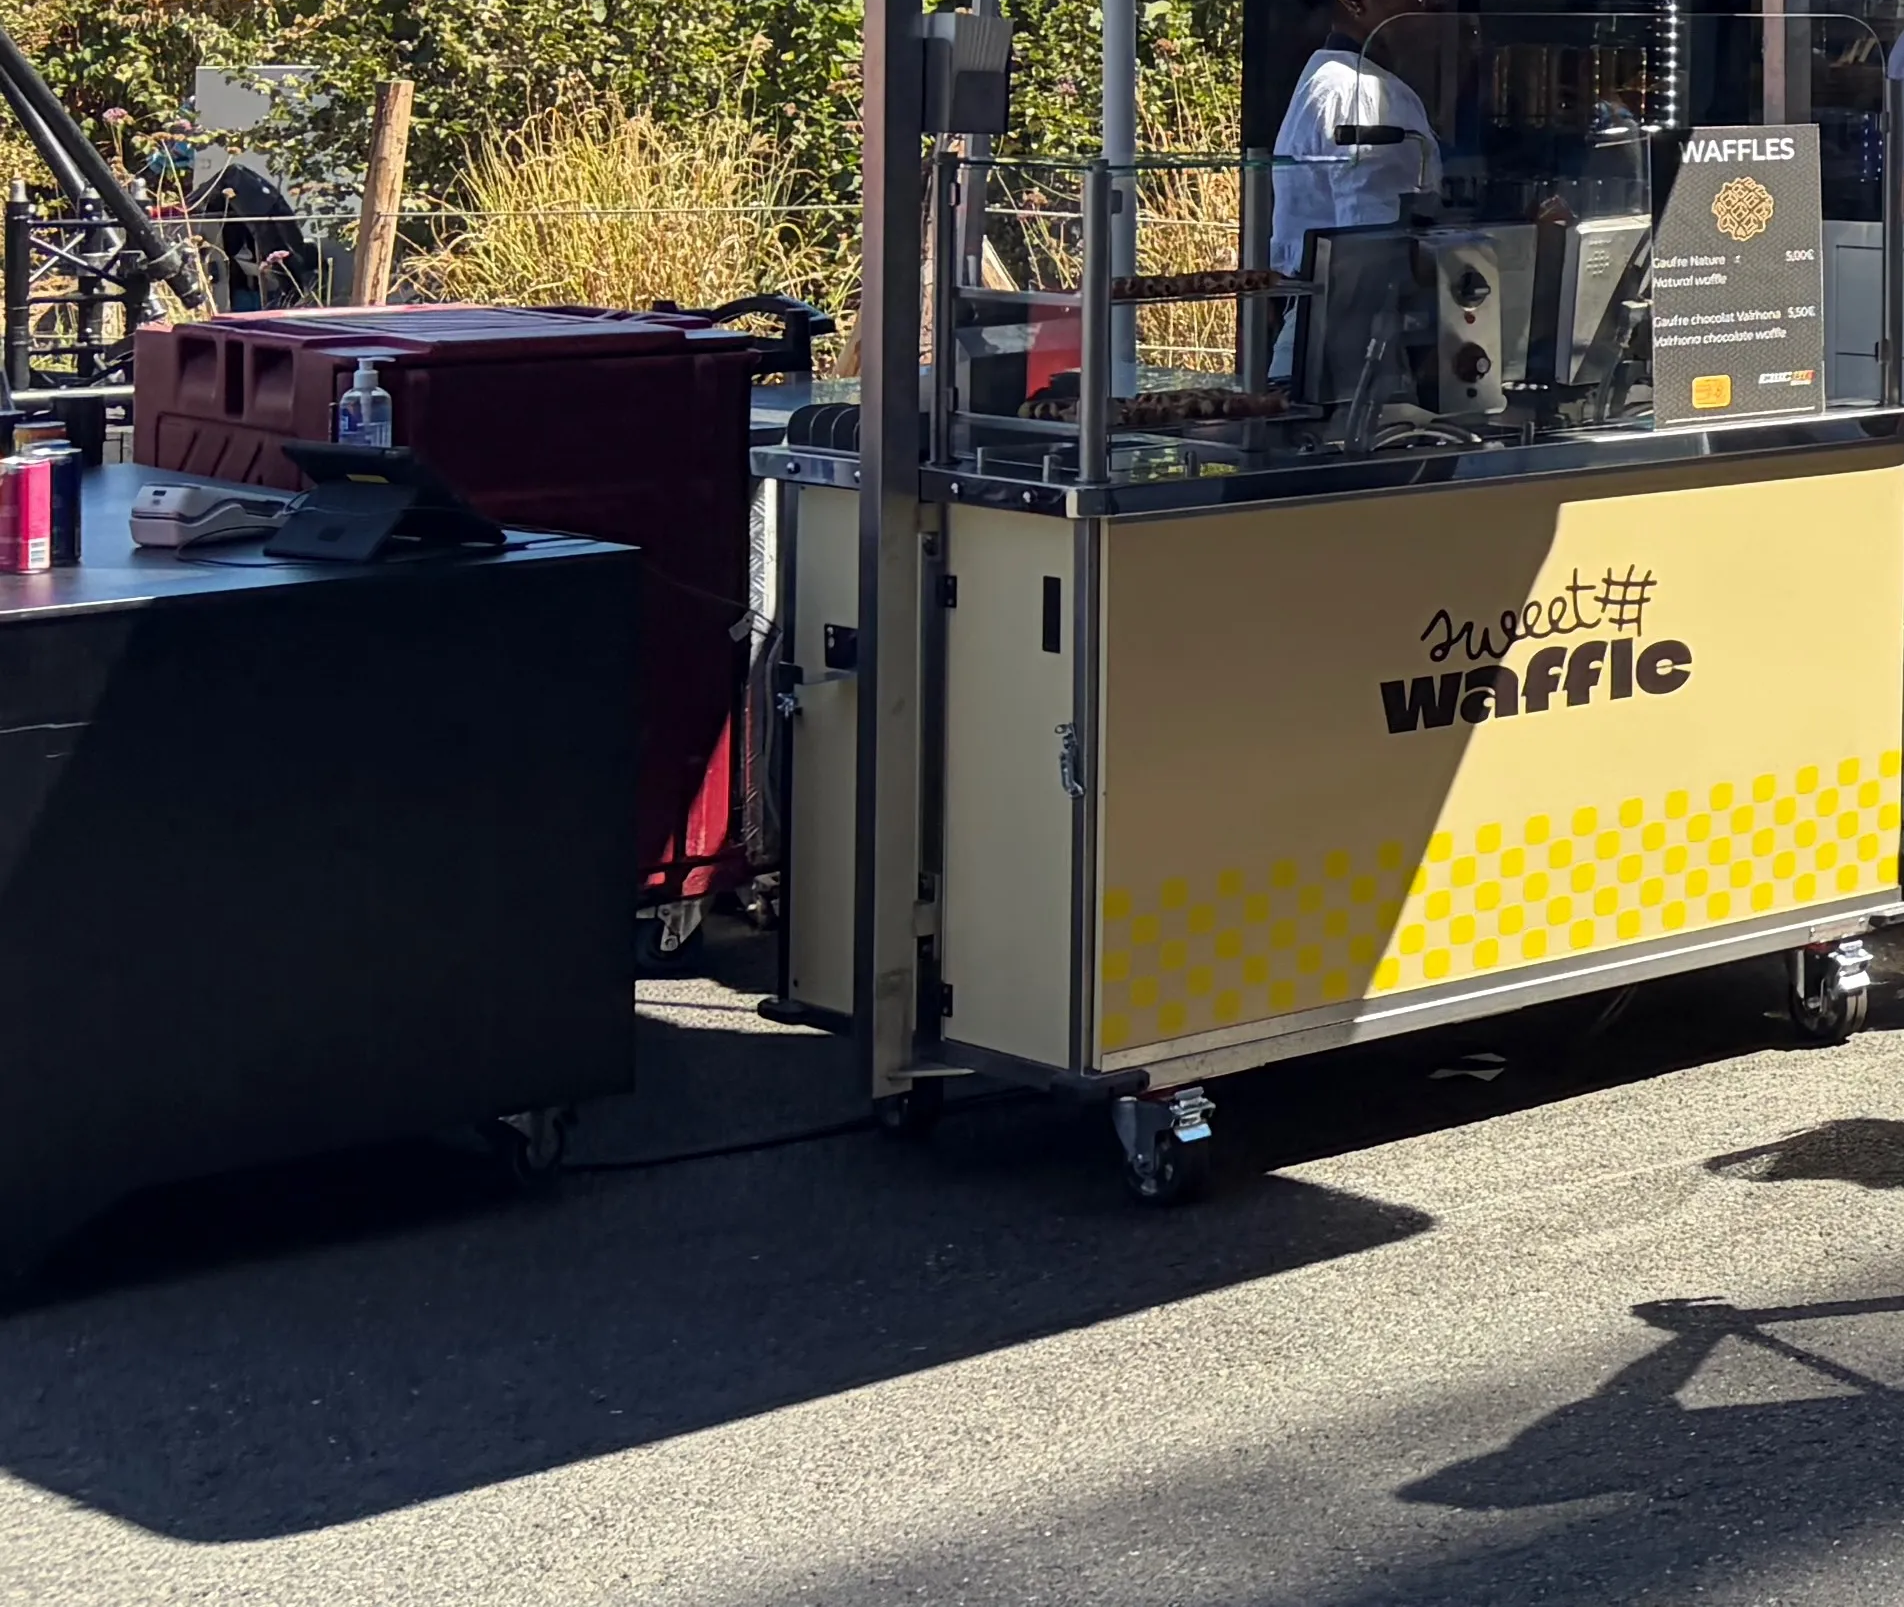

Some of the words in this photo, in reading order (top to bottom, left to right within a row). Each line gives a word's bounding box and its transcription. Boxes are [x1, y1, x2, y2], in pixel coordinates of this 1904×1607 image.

[1679, 137, 1796, 164] WAFFLES
[1652, 257, 1688, 269] Gaufre
[1652, 276, 1693, 289] Natural
[1694, 272, 1728, 286] waffle
[1652, 315, 1689, 328] Gaufre
[1690, 313, 1735, 326] chocolat
[1736, 309, 1782, 322] Valrhona
[1703, 331, 1754, 344] chocolate
[1755, 327, 1788, 339] waffle
